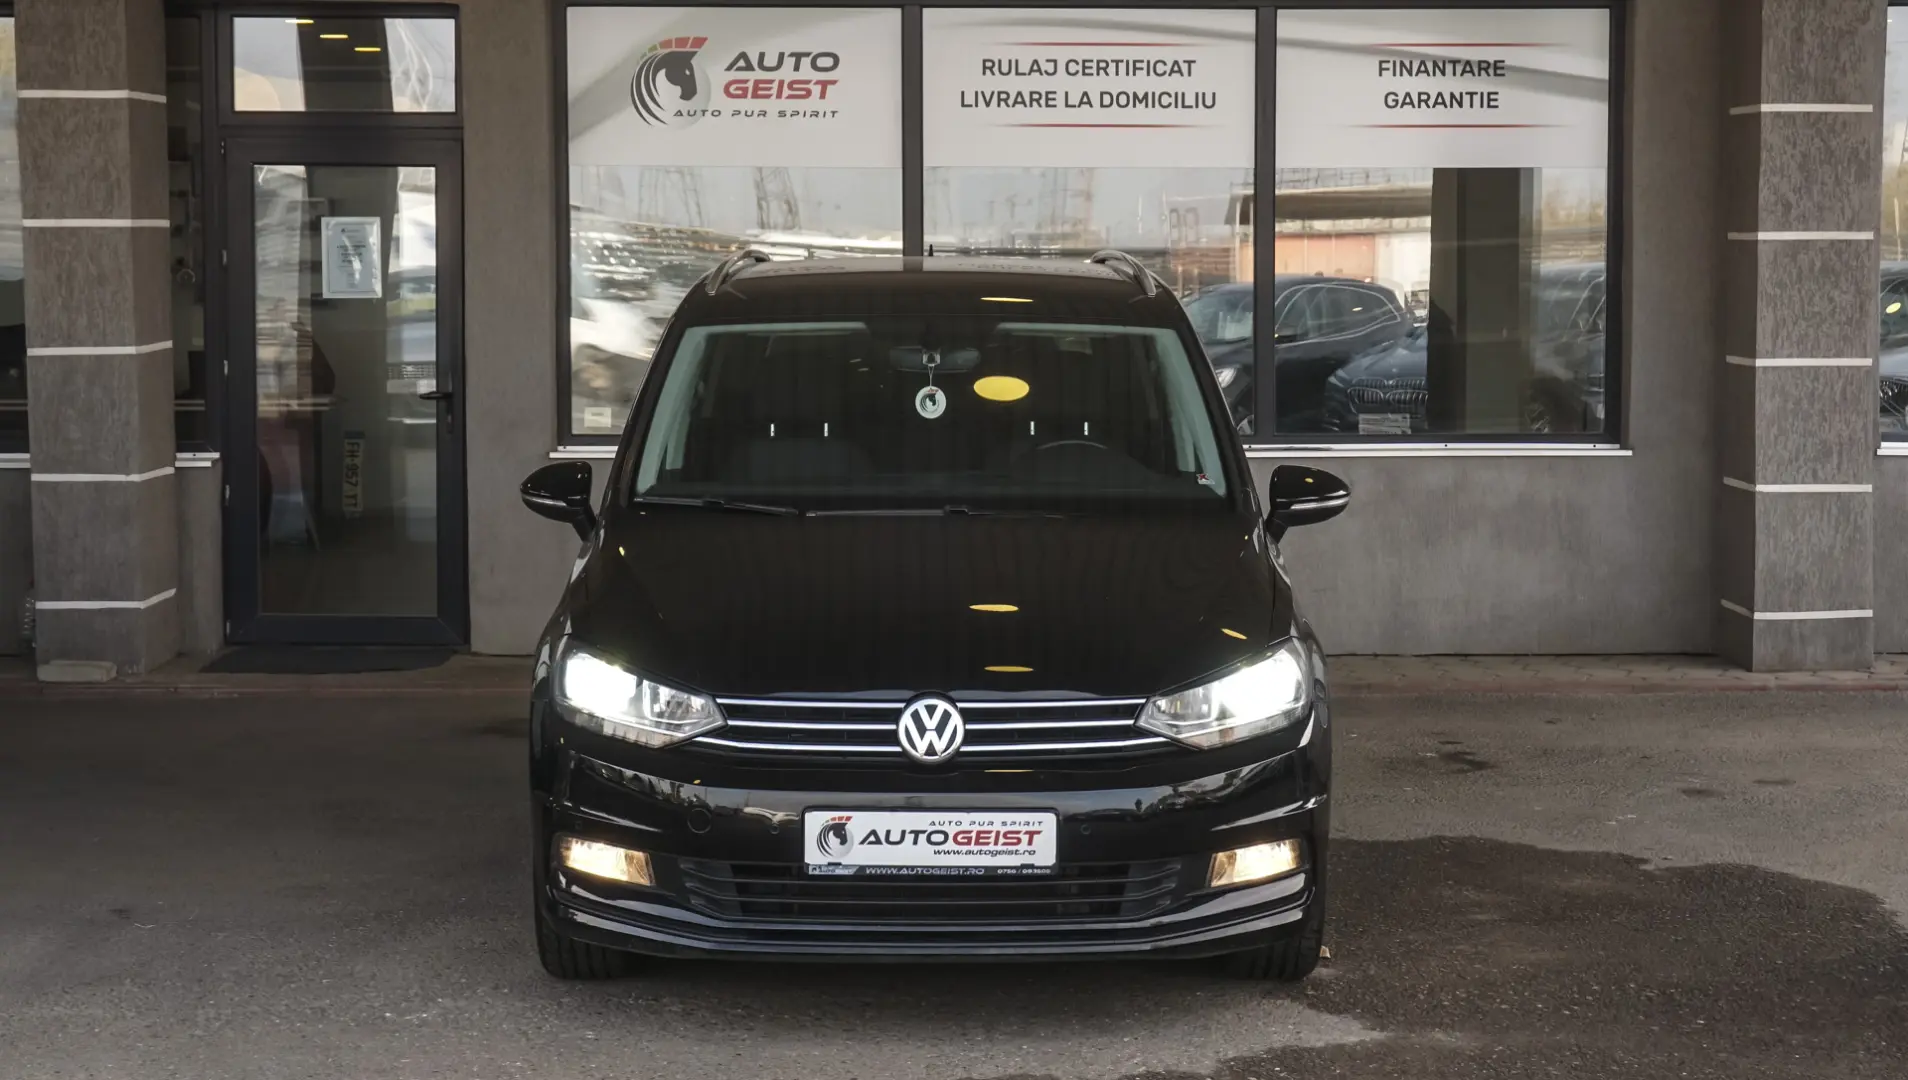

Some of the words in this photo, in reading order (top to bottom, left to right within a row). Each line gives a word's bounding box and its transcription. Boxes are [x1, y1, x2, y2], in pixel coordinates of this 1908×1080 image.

[724, 51, 840, 72] AUTO
[981, 58, 1058, 77] RULAJ
[1064, 59, 1197, 77] CERTIFICAT
[1378, 60, 1506, 77] FINANTARE
[723, 79, 839, 100] GEIST
[960, 90, 1058, 108] LIVRARE
[1063, 91, 1094, 108] LA
[1099, 91, 1217, 109] DOMICILIU
[1383, 91, 1499, 109] GARANTIE
[673, 109, 722, 117] AUTO
[731, 109, 768, 118] PUR
[777, 109, 839, 118] SPIRIT
[933, 848, 1036, 857] www.autogeist.ro
[865, 867, 985, 875] WWW.AUTOGEIST.RO
